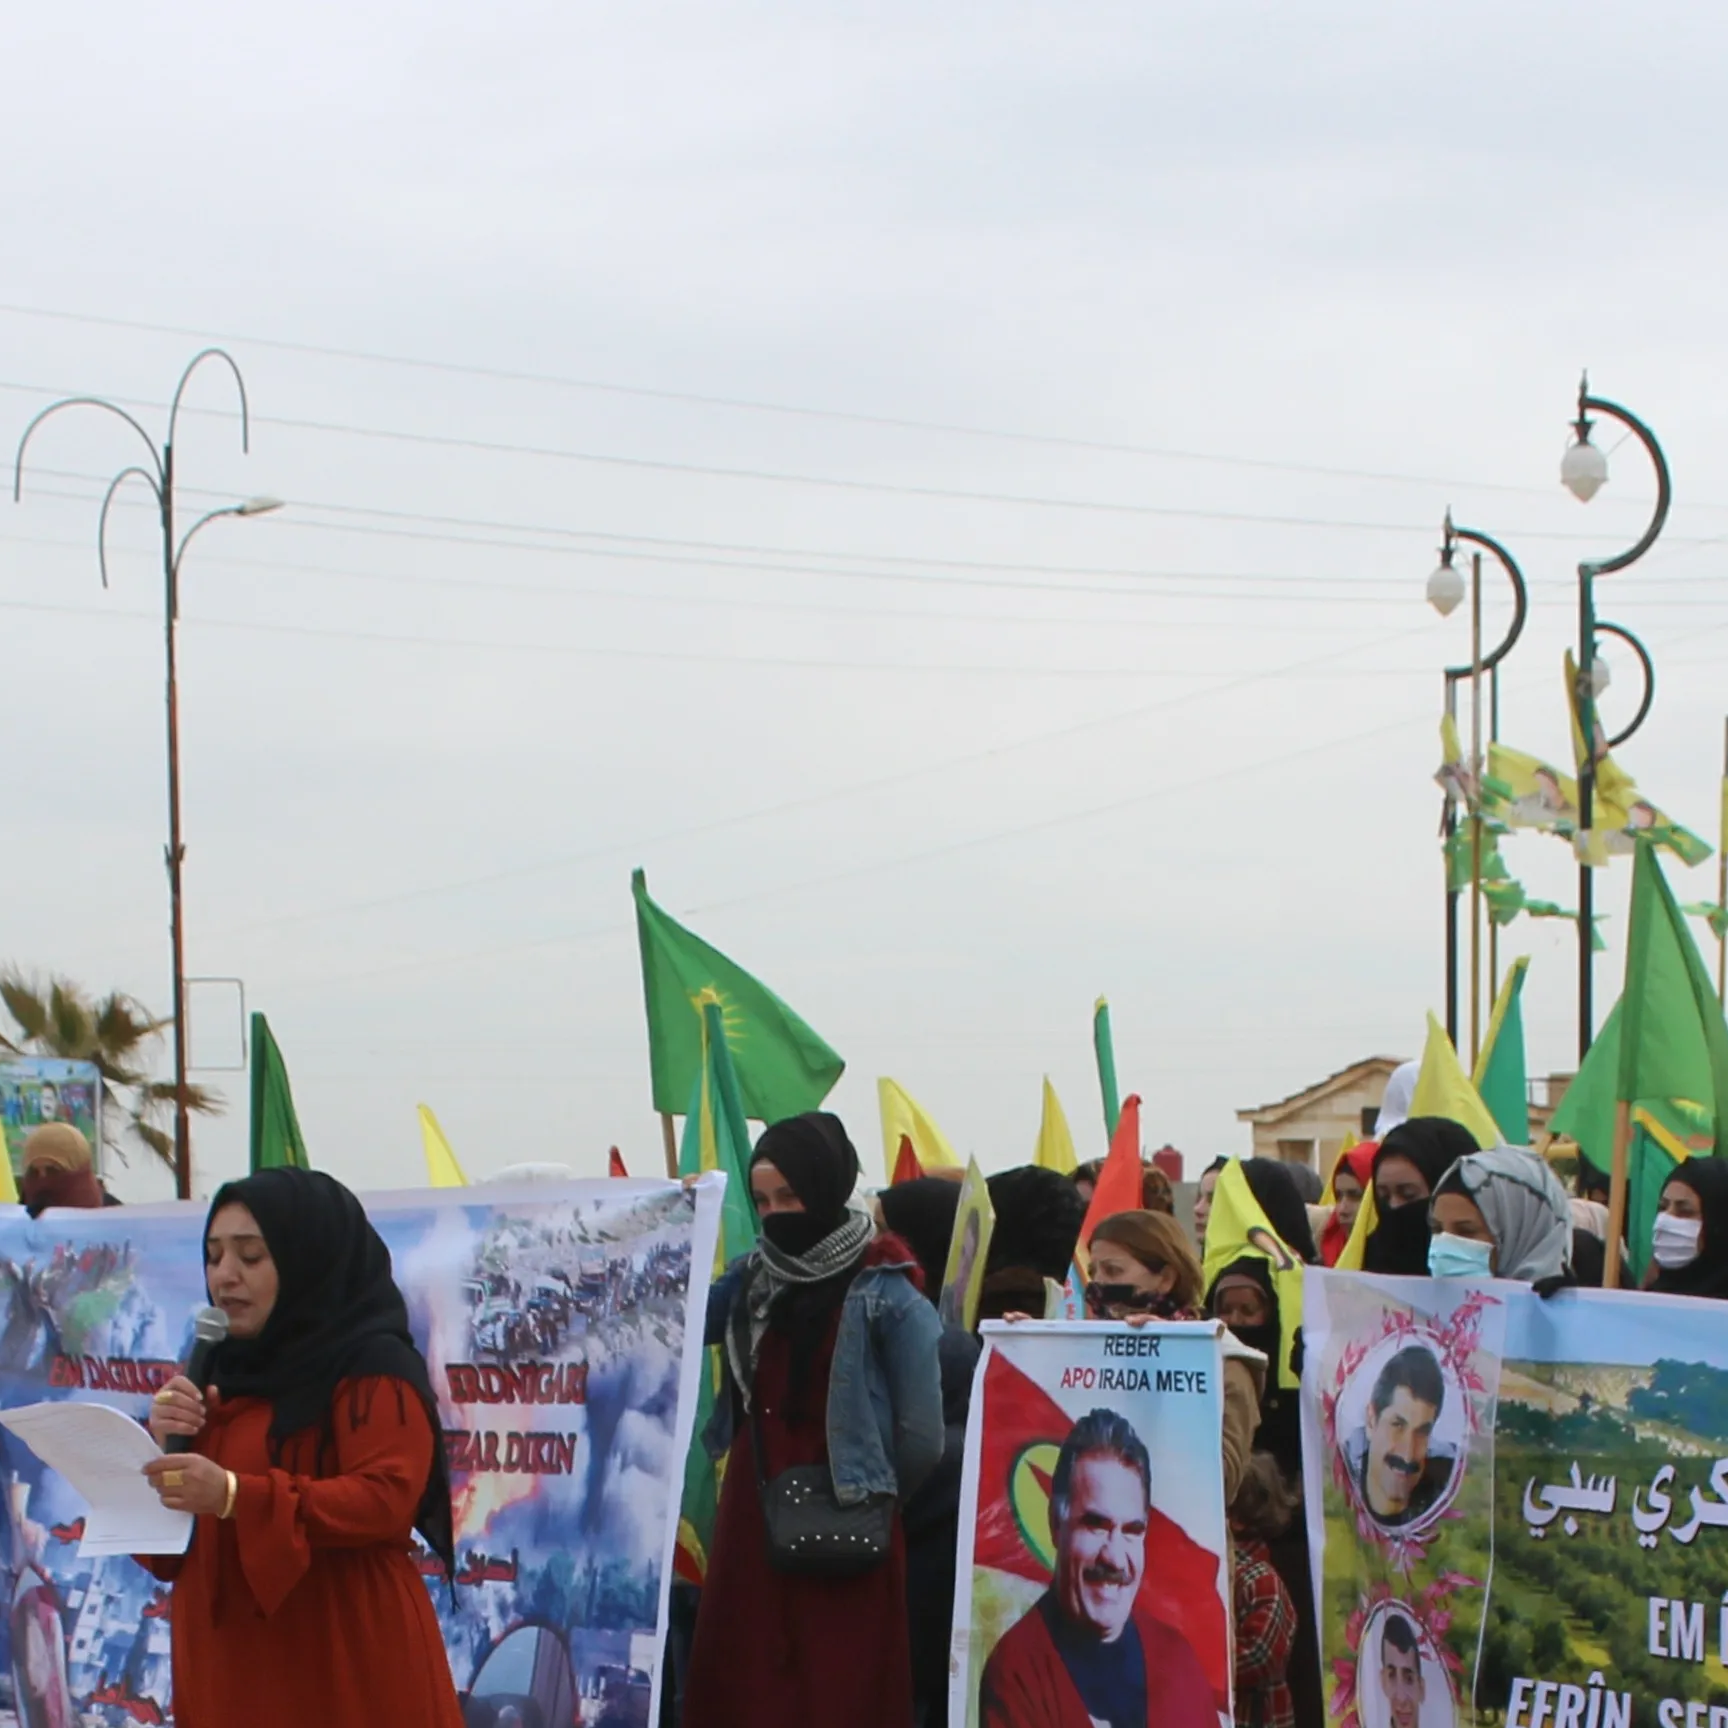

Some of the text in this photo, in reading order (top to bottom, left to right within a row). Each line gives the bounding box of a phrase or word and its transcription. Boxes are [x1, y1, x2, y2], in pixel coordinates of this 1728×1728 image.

[1103, 1334, 1161, 1358] REBER
[1060, 1367, 1208, 1394] APO IRADA MEYE
[502, 1431, 578, 1476] DIKIN
[1648, 1596, 1706, 1663] EM
